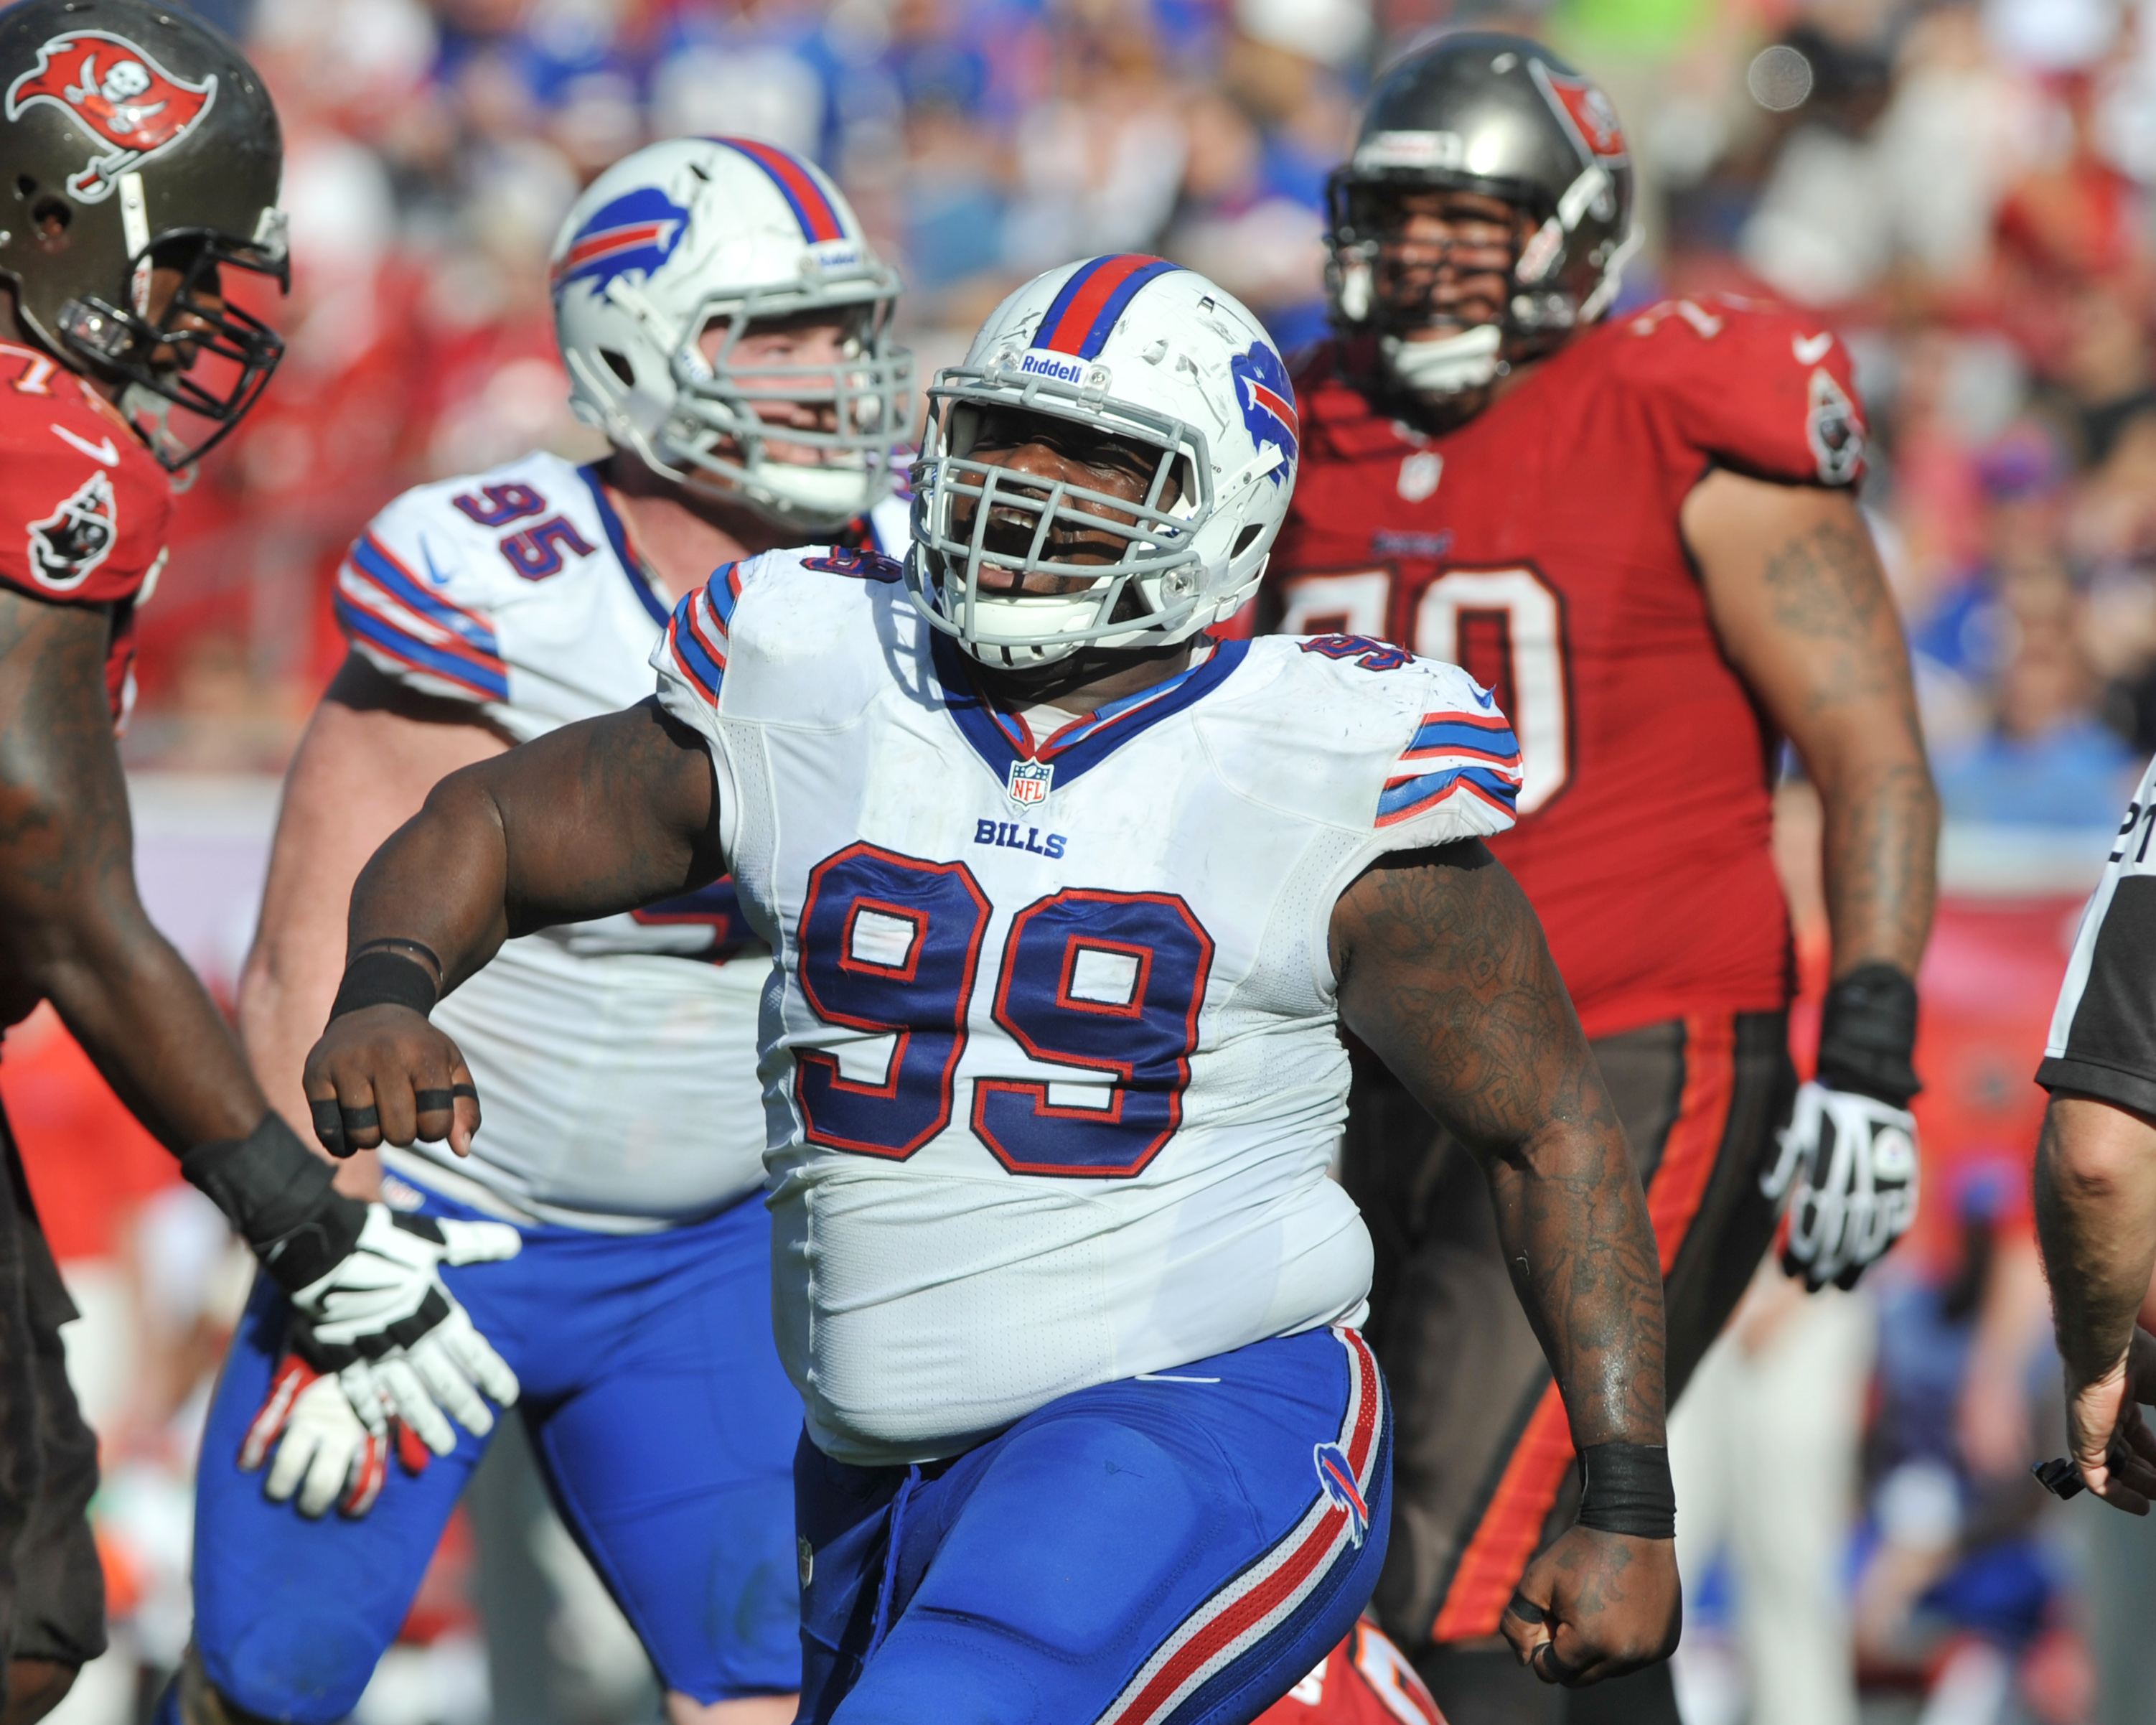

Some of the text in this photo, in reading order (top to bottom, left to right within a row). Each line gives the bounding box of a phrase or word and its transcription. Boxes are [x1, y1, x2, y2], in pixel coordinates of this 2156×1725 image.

[1021, 355, 1083, 383] Riddell
[452, 484, 596, 581] 95
[1013, 780, 1042, 802] NFL
[974, 818, 1068, 859] BILLS
[789, 839, 1216, 1179] 99
